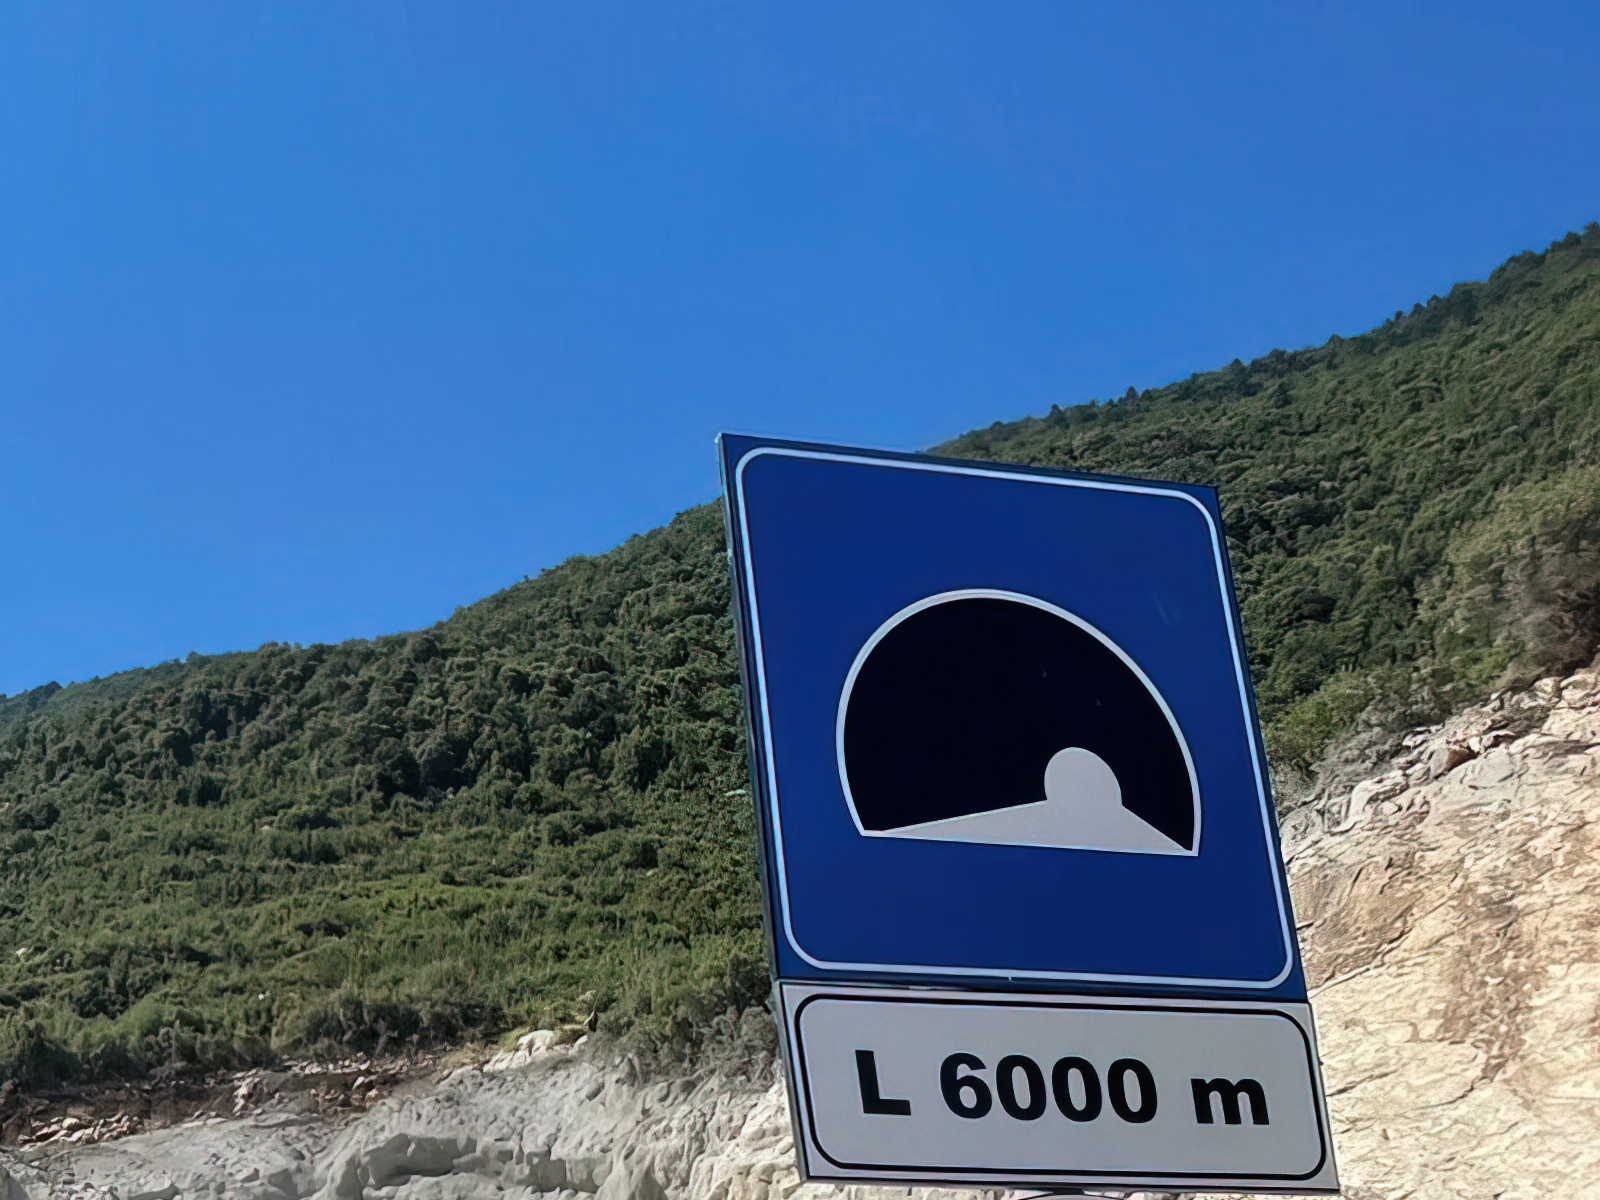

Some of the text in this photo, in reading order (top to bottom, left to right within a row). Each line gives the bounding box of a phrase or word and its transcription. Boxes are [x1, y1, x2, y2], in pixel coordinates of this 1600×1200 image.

[854, 1049, 1270, 1126] L 6000 m
